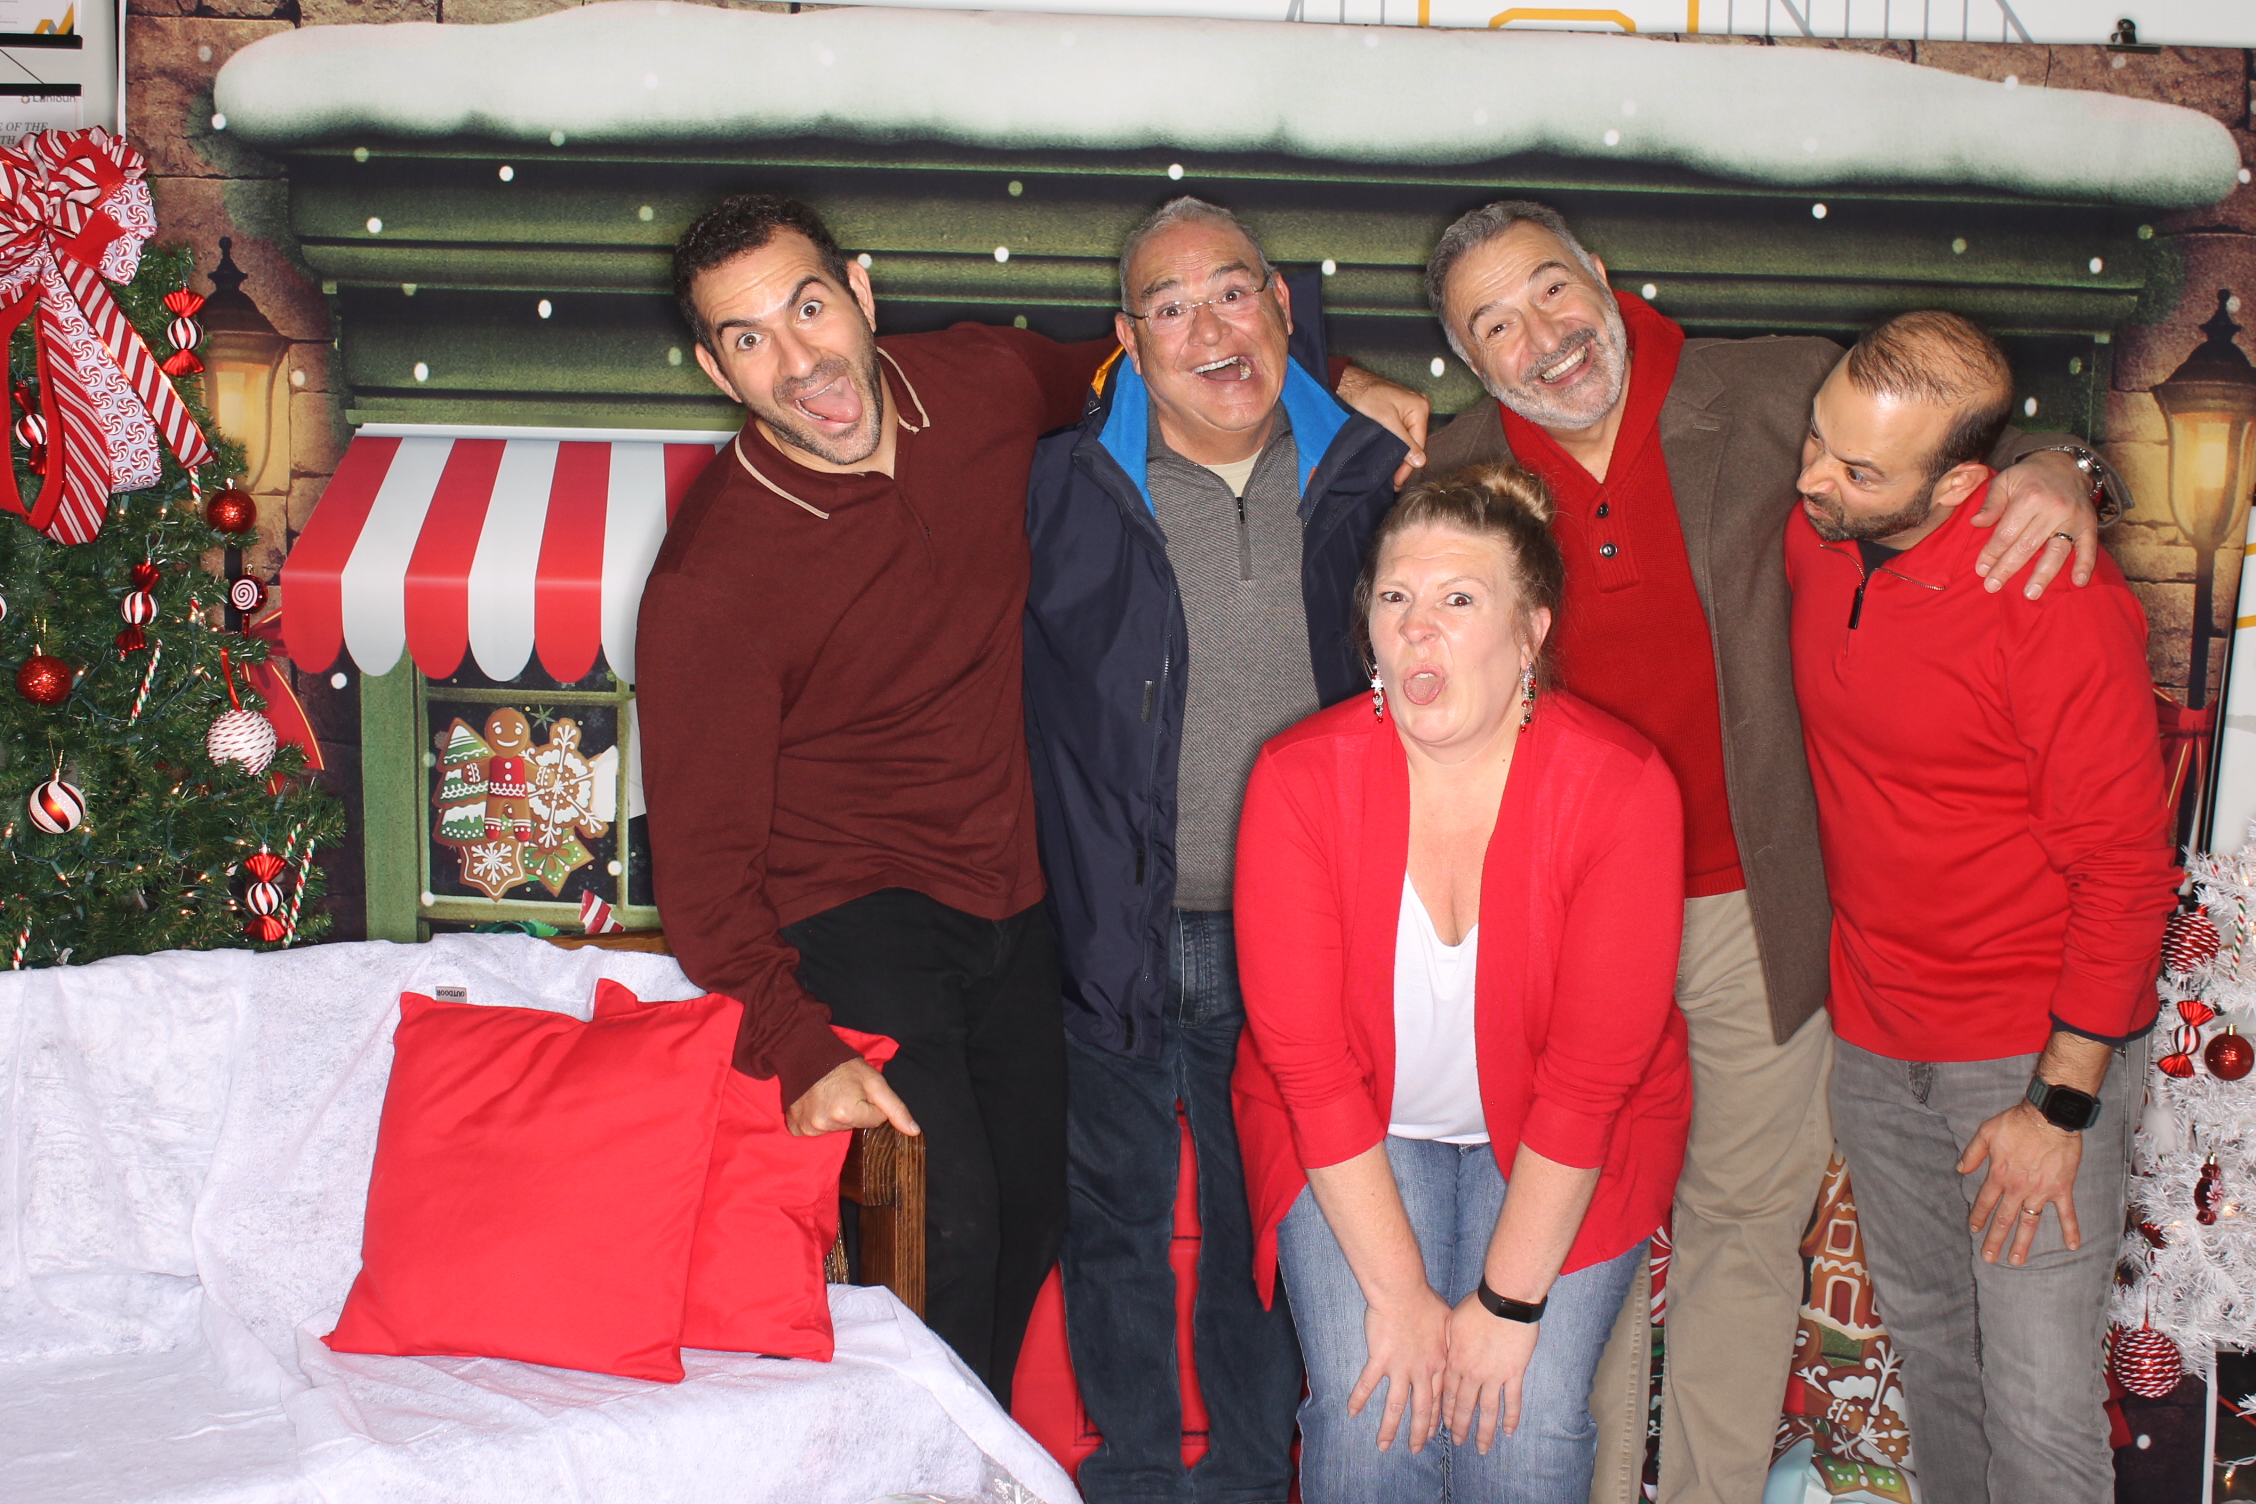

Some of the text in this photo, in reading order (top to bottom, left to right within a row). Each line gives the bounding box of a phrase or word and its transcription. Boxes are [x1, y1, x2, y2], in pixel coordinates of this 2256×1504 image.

[5, 122, 22, 131] OF
[25, 122, 48, 131] THE
[436, 989, 465, 997] OUTDOOR
